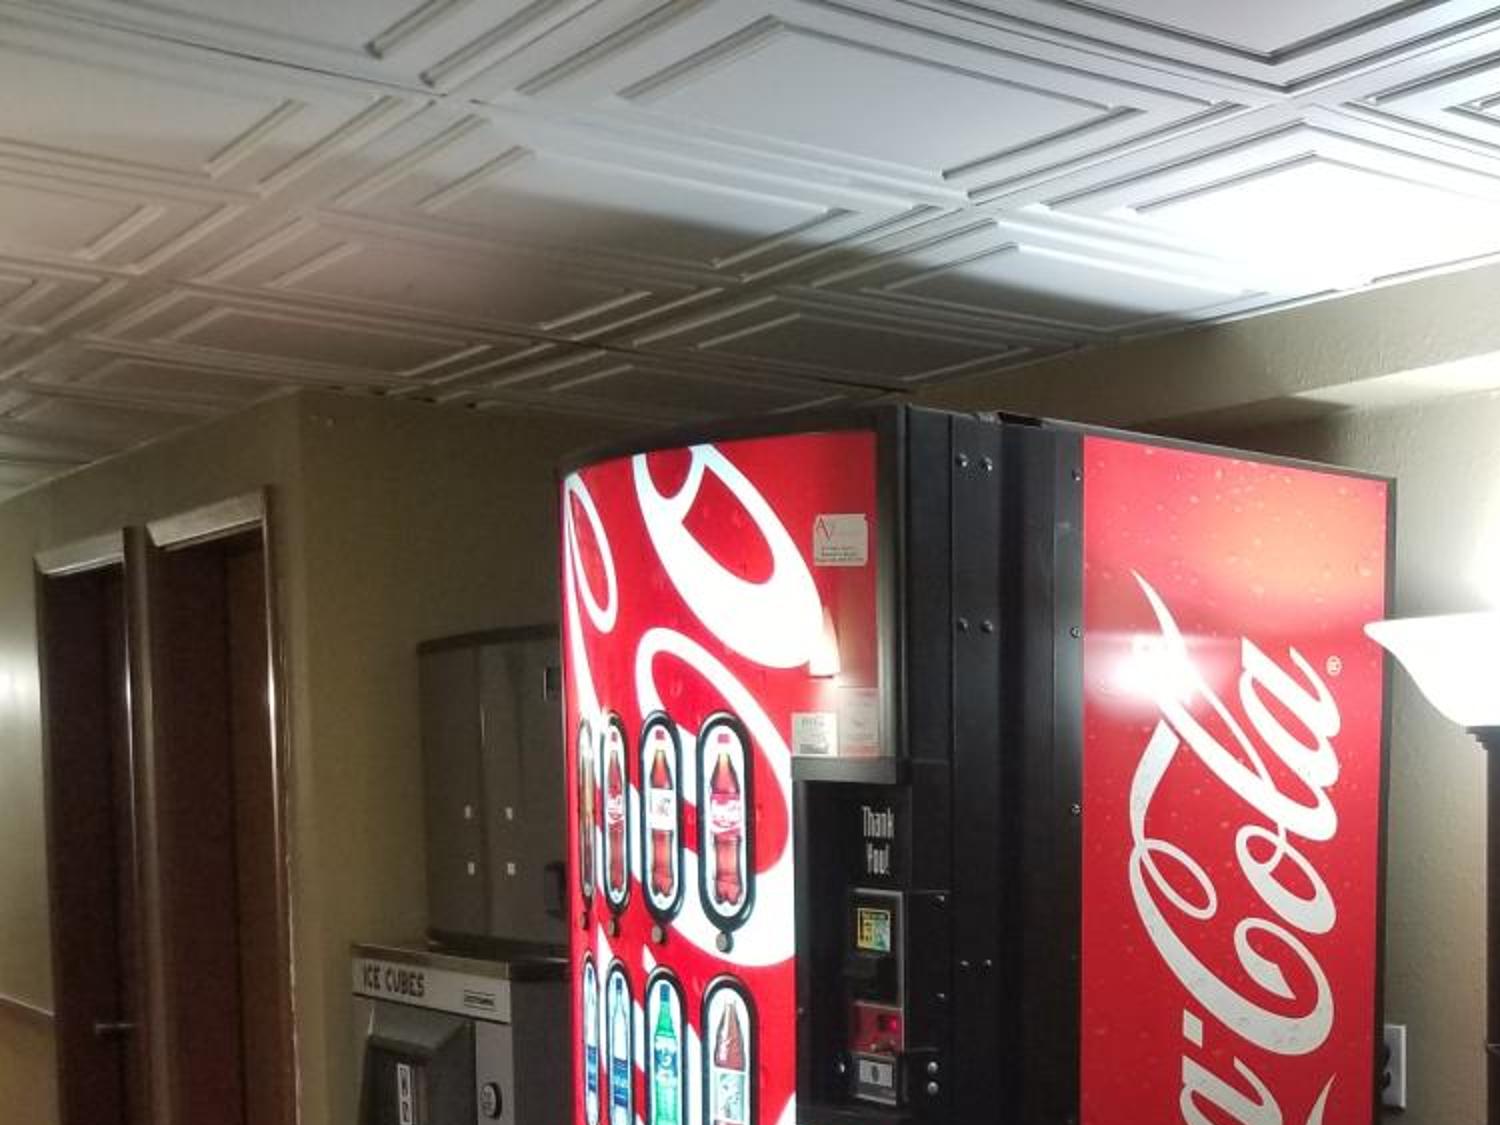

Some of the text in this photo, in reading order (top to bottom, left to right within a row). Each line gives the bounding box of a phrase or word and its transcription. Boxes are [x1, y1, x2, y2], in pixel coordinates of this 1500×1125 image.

[862, 805, 896, 840] Thank
[866, 841, 890, 875] You!
[363, 963, 426, 998] ICE CUBES
